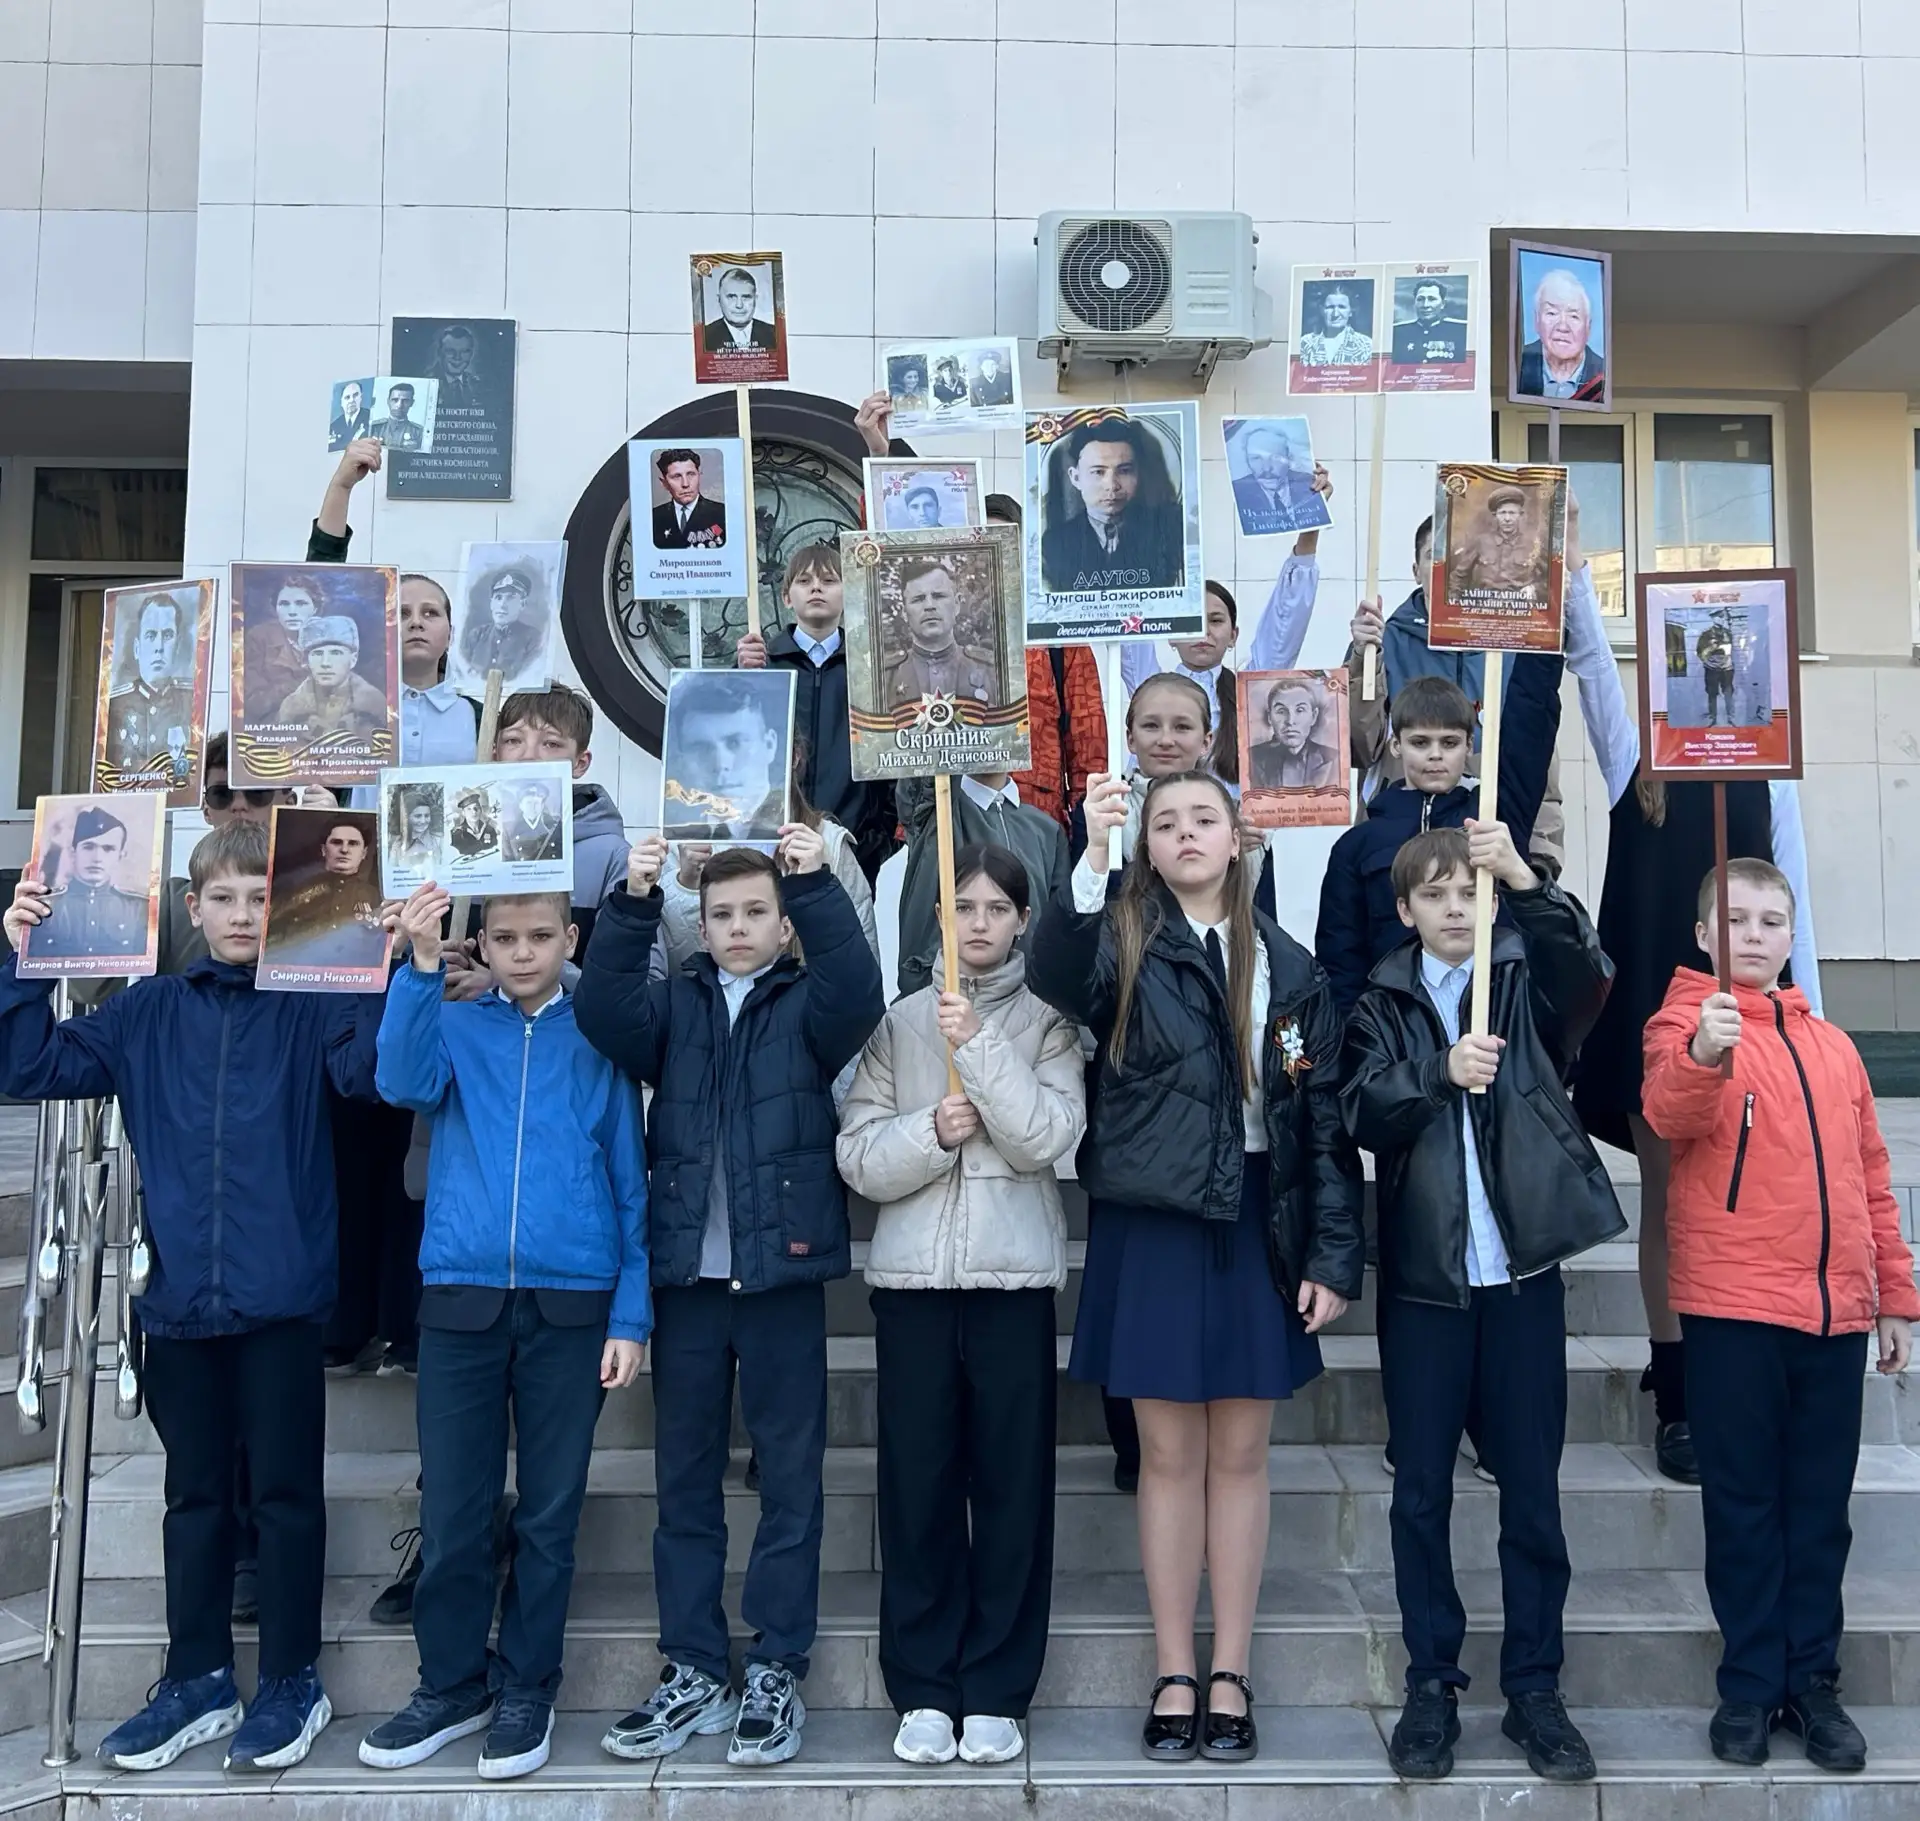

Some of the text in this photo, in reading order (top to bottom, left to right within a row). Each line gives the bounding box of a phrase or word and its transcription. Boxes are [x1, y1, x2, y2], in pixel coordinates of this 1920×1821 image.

[435, 420, 471, 429] ОВЕТСКОГО
[468, 472, 502, 481] ГАГАРИНА
[659, 559, 722, 569] Мирошников
[650, 570, 732, 580] Свирид Иванович
[1073, 569, 1150, 590] ДАУТОВ
[1045, 589, 1183, 606] Тунгаш Бажирович
[244, 724, 309, 732] МАРТЫНОВА
[256, 735, 297, 743] Клавдия
[895, 729, 991, 751] Скрипник
[309, 747, 371, 755] МАРТЫНОВ
[320, 758, 388, 767] Прокопьевич
[878, 749, 1011, 767] Михаил Денисович
[120, 771, 167, 783] СЕРГИЕНКО
[22, 959, 151, 970] Смирнов Виктор Николаевич
[270, 969, 372, 983] Смирнов Николай
